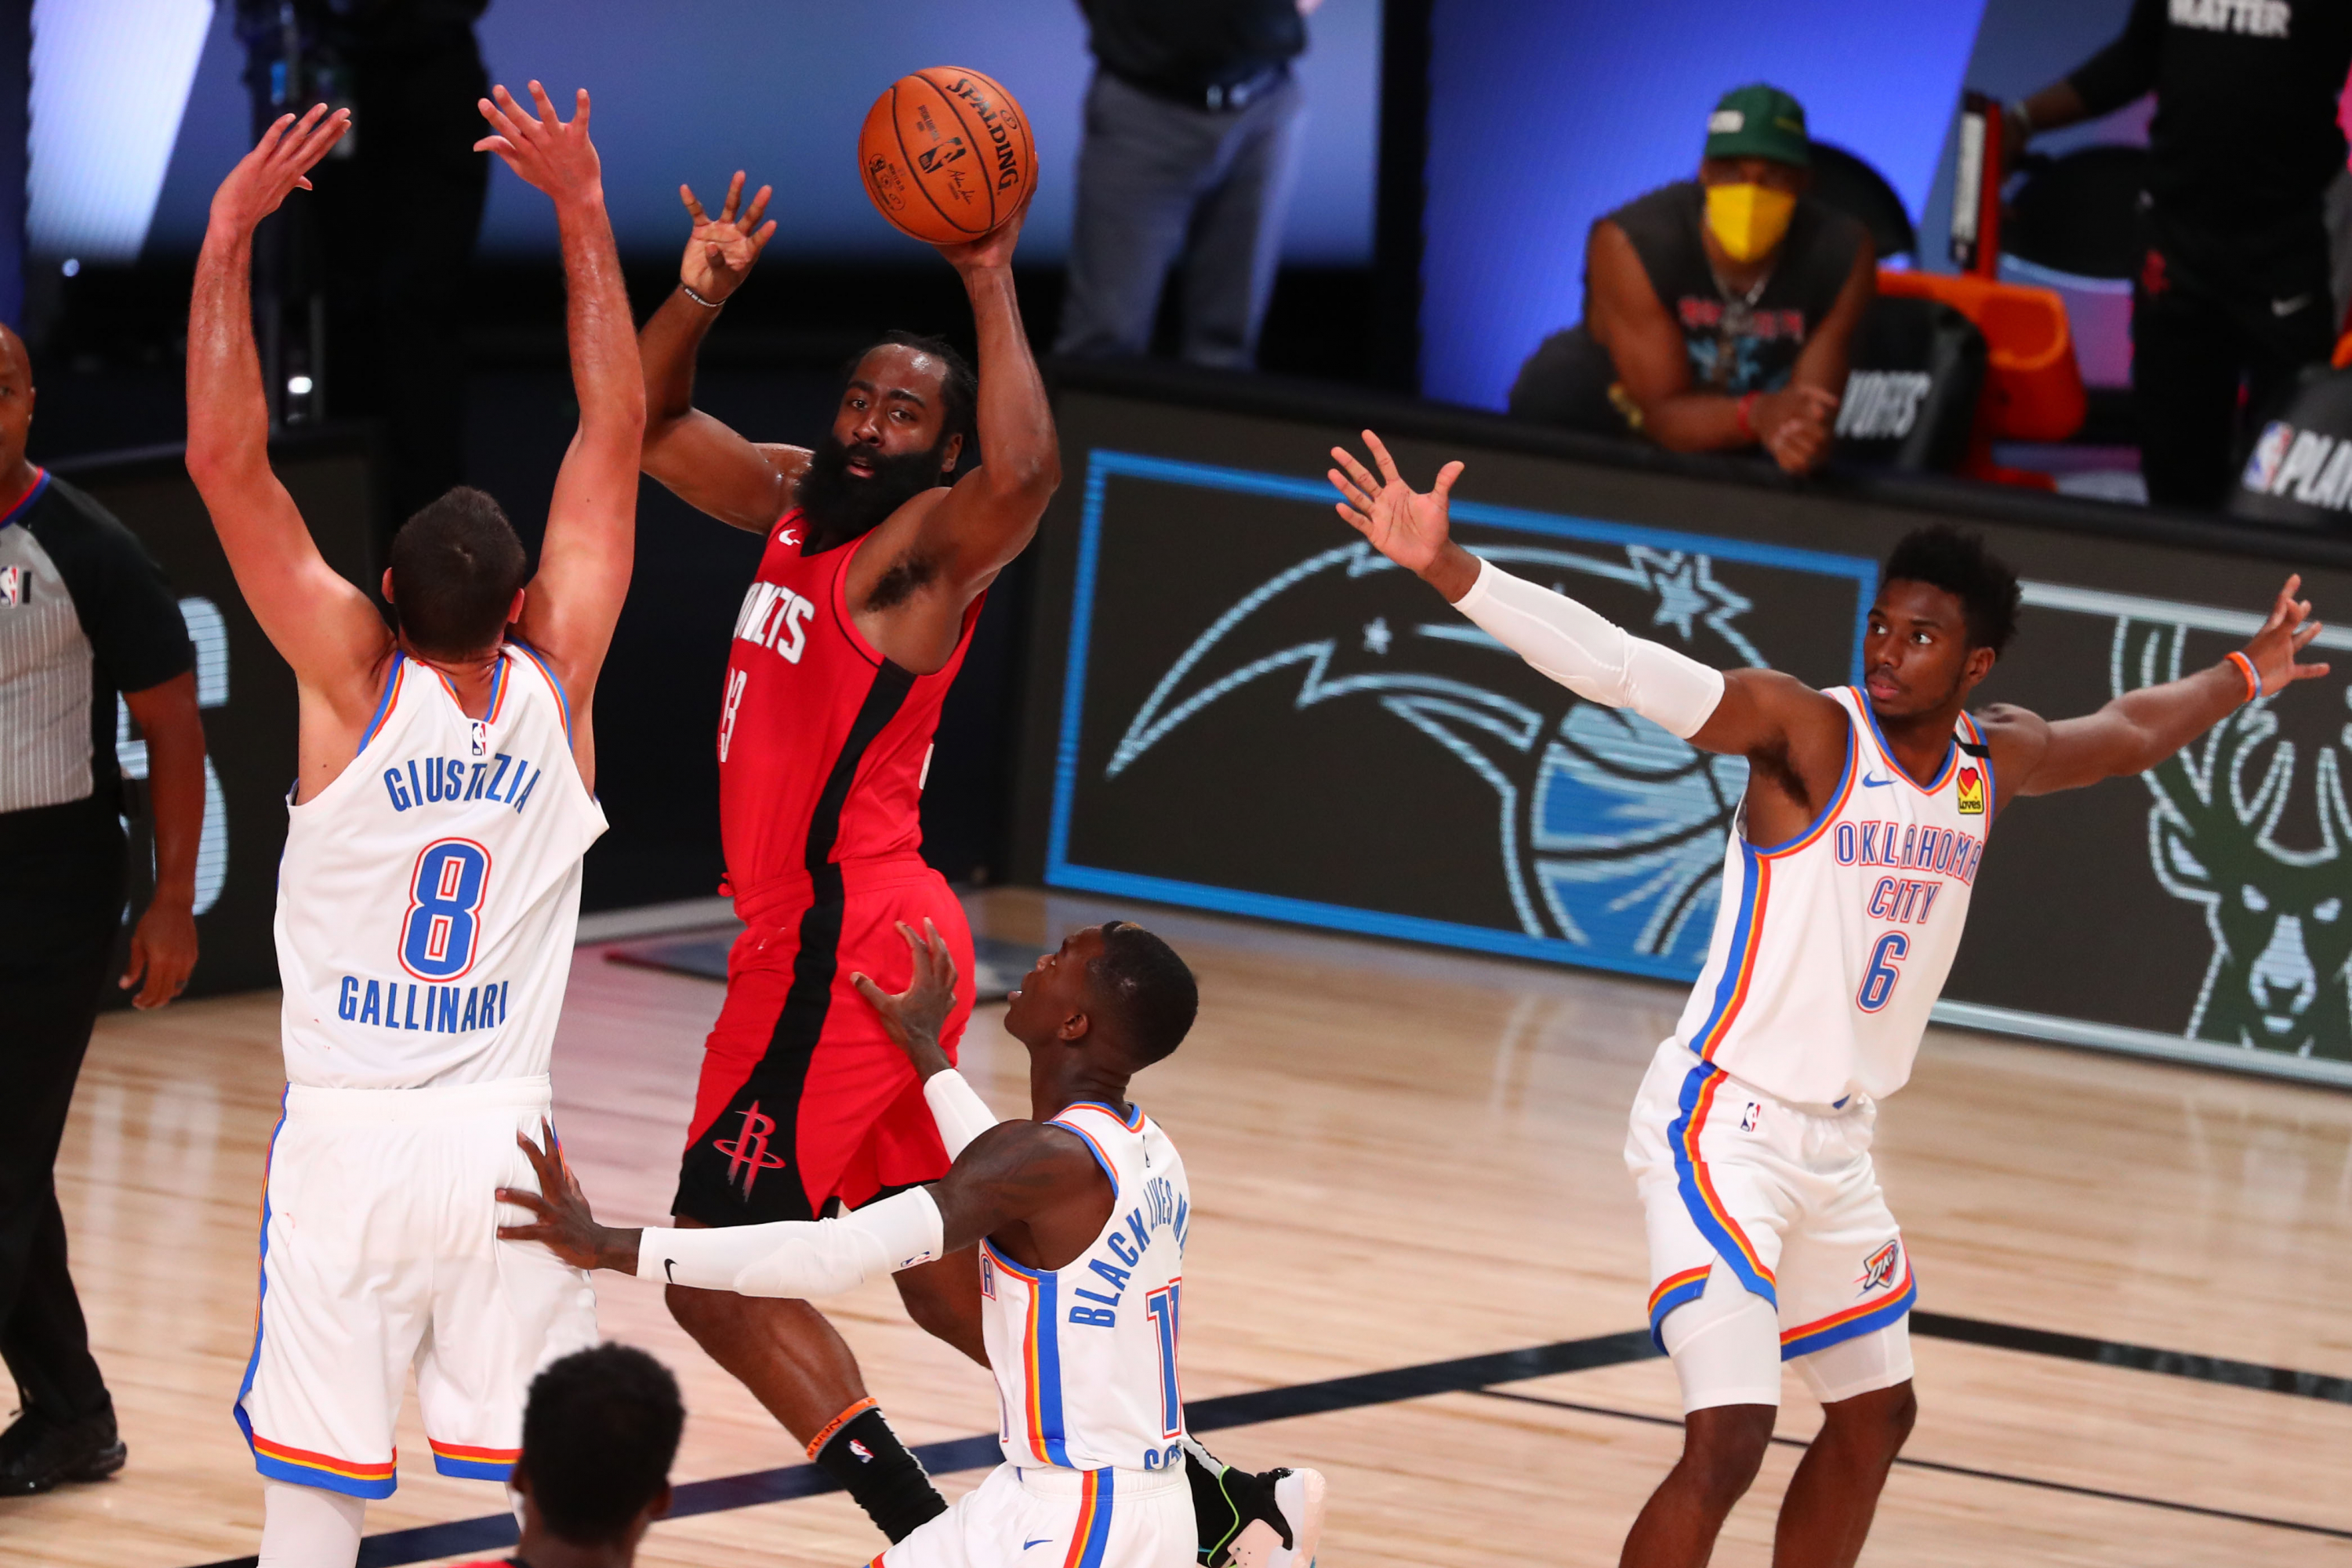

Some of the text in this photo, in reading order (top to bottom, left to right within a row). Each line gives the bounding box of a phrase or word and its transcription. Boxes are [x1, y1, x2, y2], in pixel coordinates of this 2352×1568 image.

[946, 78, 1018, 192] SPALDING
[1835, 820, 1984, 886] OKLAHOMA
[397, 837, 492, 982] 8
[1867, 876, 1942, 924] CITY
[338, 975, 509, 1033] GALLINARI
[1856, 930, 1911, 1014] 6
[1069, 1207, 1151, 1328] BLACK
[1143, 1177, 1173, 1232] LIVES
